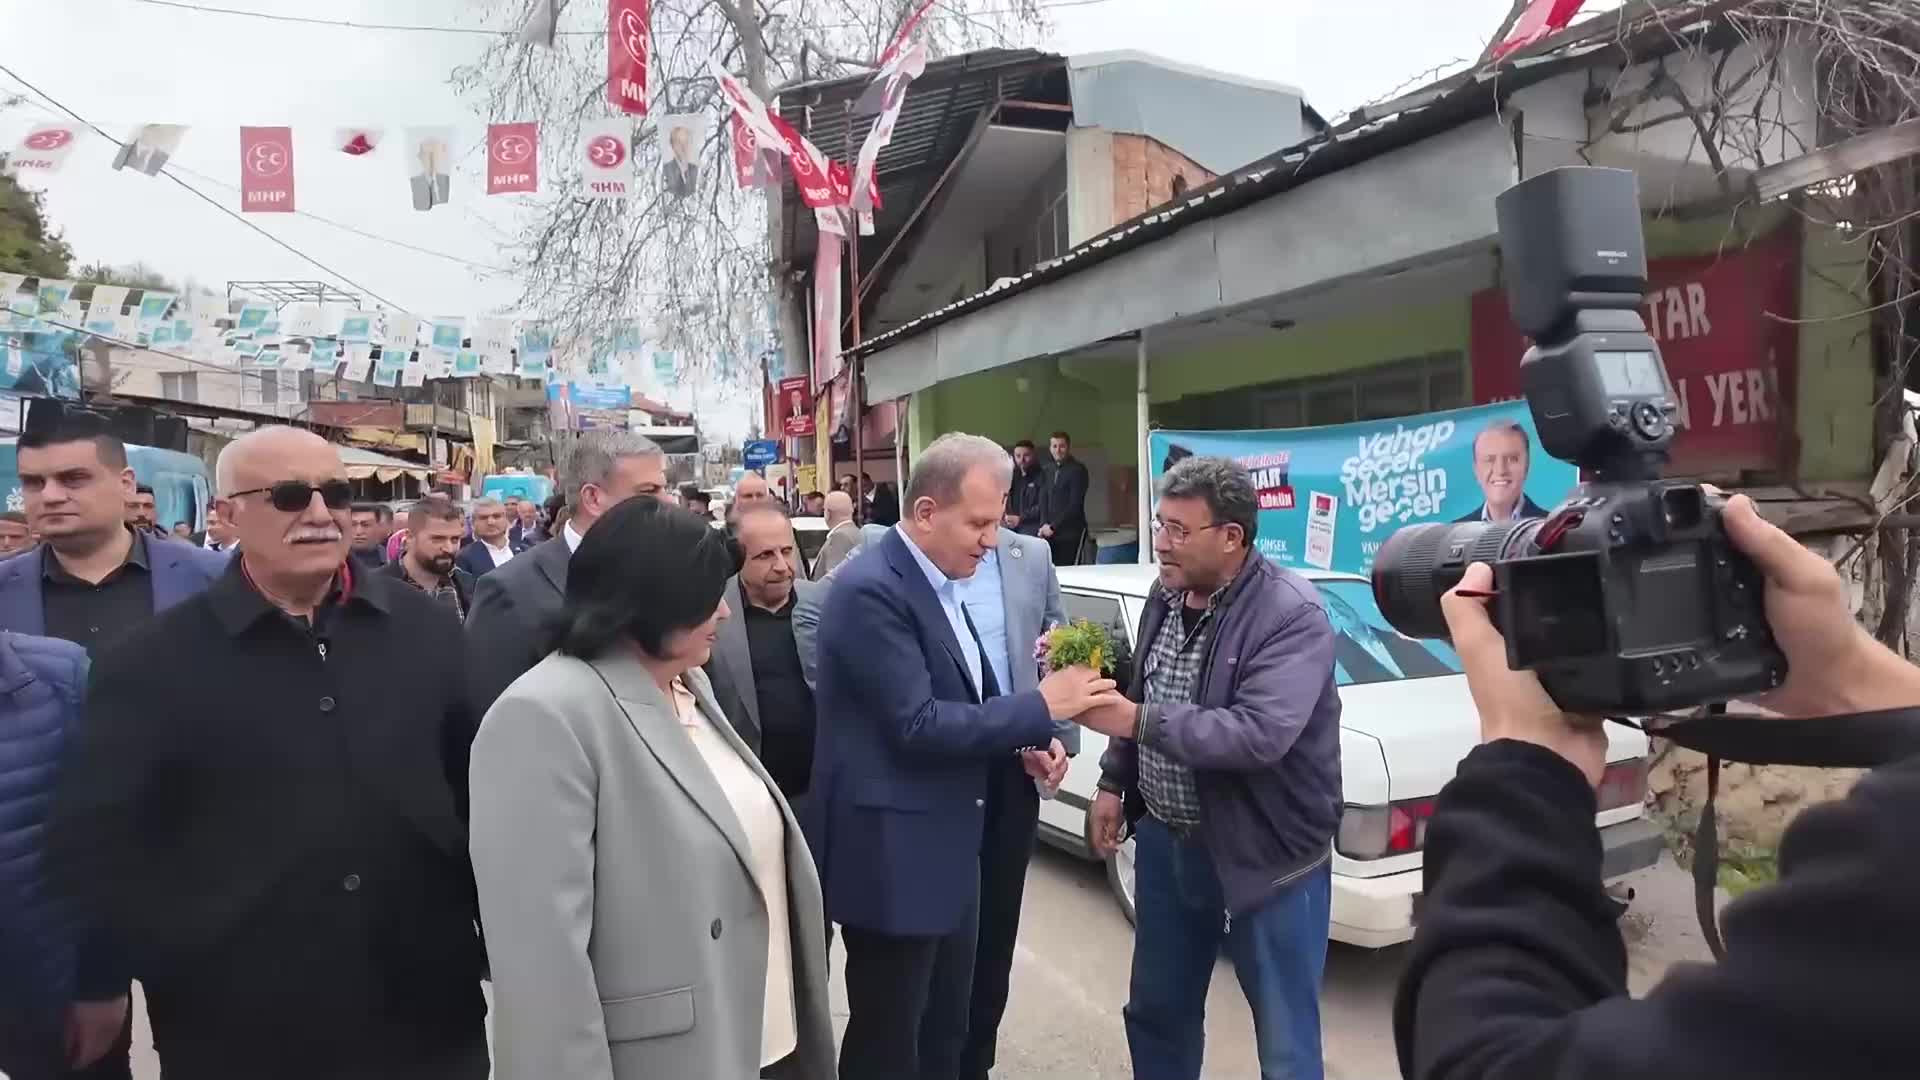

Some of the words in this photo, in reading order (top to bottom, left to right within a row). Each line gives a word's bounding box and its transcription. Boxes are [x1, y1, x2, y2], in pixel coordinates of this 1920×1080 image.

[247, 190, 287, 202] MHP
[493, 174, 529, 185] MHP
[1646, 282, 1712, 340] TAR
[1359, 420, 1455, 460] Vahap
[1345, 464, 1447, 507] Mersin
[1359, 491, 1447, 533] geçer
